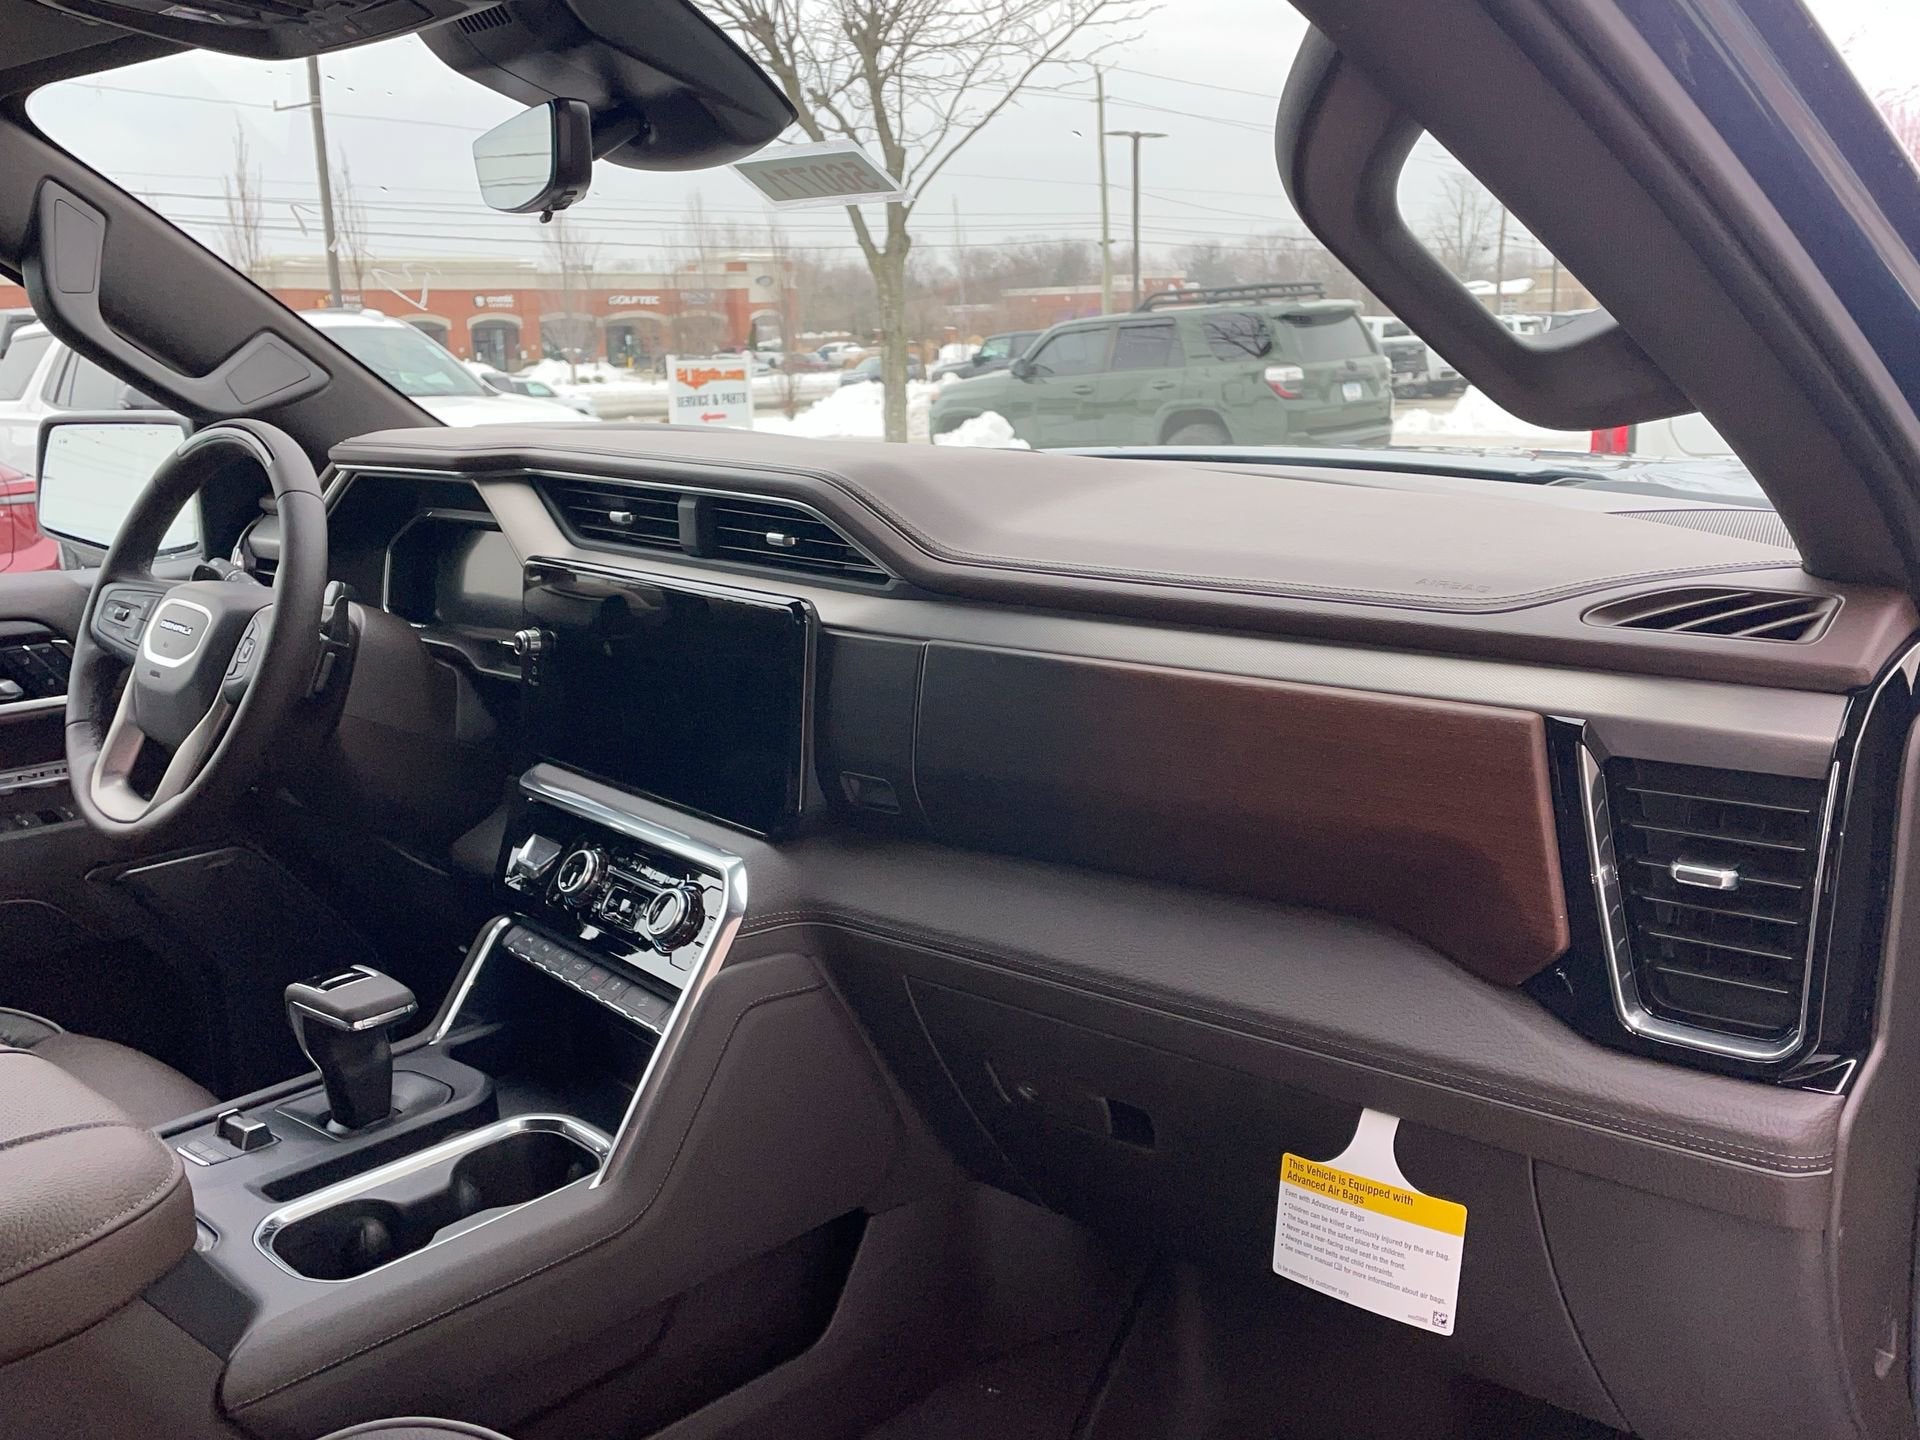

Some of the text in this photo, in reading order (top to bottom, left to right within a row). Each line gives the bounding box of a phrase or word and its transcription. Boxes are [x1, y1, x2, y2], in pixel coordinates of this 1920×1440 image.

[677, 391, 747, 408] SERVICE & PARTS
[1287, 1170, 1364, 1205] Advanced Air Bags
[1288, 1159, 1413, 1206] This Vehicle is Equipped with
[1285, 1188, 1365, 1222] Even with Advanced Air Bags
[1287, 1212, 1296, 1221] The
[1310, 1222, 1321, 1230] seat
[1327, 1228, 1336, 1236] the
[1337, 1231, 1353, 1242] safest
[1354, 1237, 1369, 1247] place
[1288, 1203, 1309, 1215] Children
[1310, 1211, 1320, 1219] can
[1329, 1217, 1344, 1228] killed
[1353, 1227, 1379, 1240] seriously
[1381, 1235, 1403, 1247] injured
[1403, 1242, 1411, 1250] by
[1413, 1245, 1424, 1253] the
[1425, 1248, 1433, 1256] air
[1301, 1229, 1309, 1237] put
[1344, 1244, 1357, 1254] child
[1359, 1250, 1371, 1259] seat
[1379, 1256, 1388, 1264] the
[1285, 1233, 1302, 1245] Always
[1325, 1248, 1338, 1258] belts
[1339, 1253, 1349, 1262] and
[1350, 1257, 1364, 1268] child
[1343, 1266, 1351, 1274] for
[1367, 1275, 1400, 1291] information
[1401, 1286, 1418, 1296] about
[1419, 1291, 1428, 1299] air
